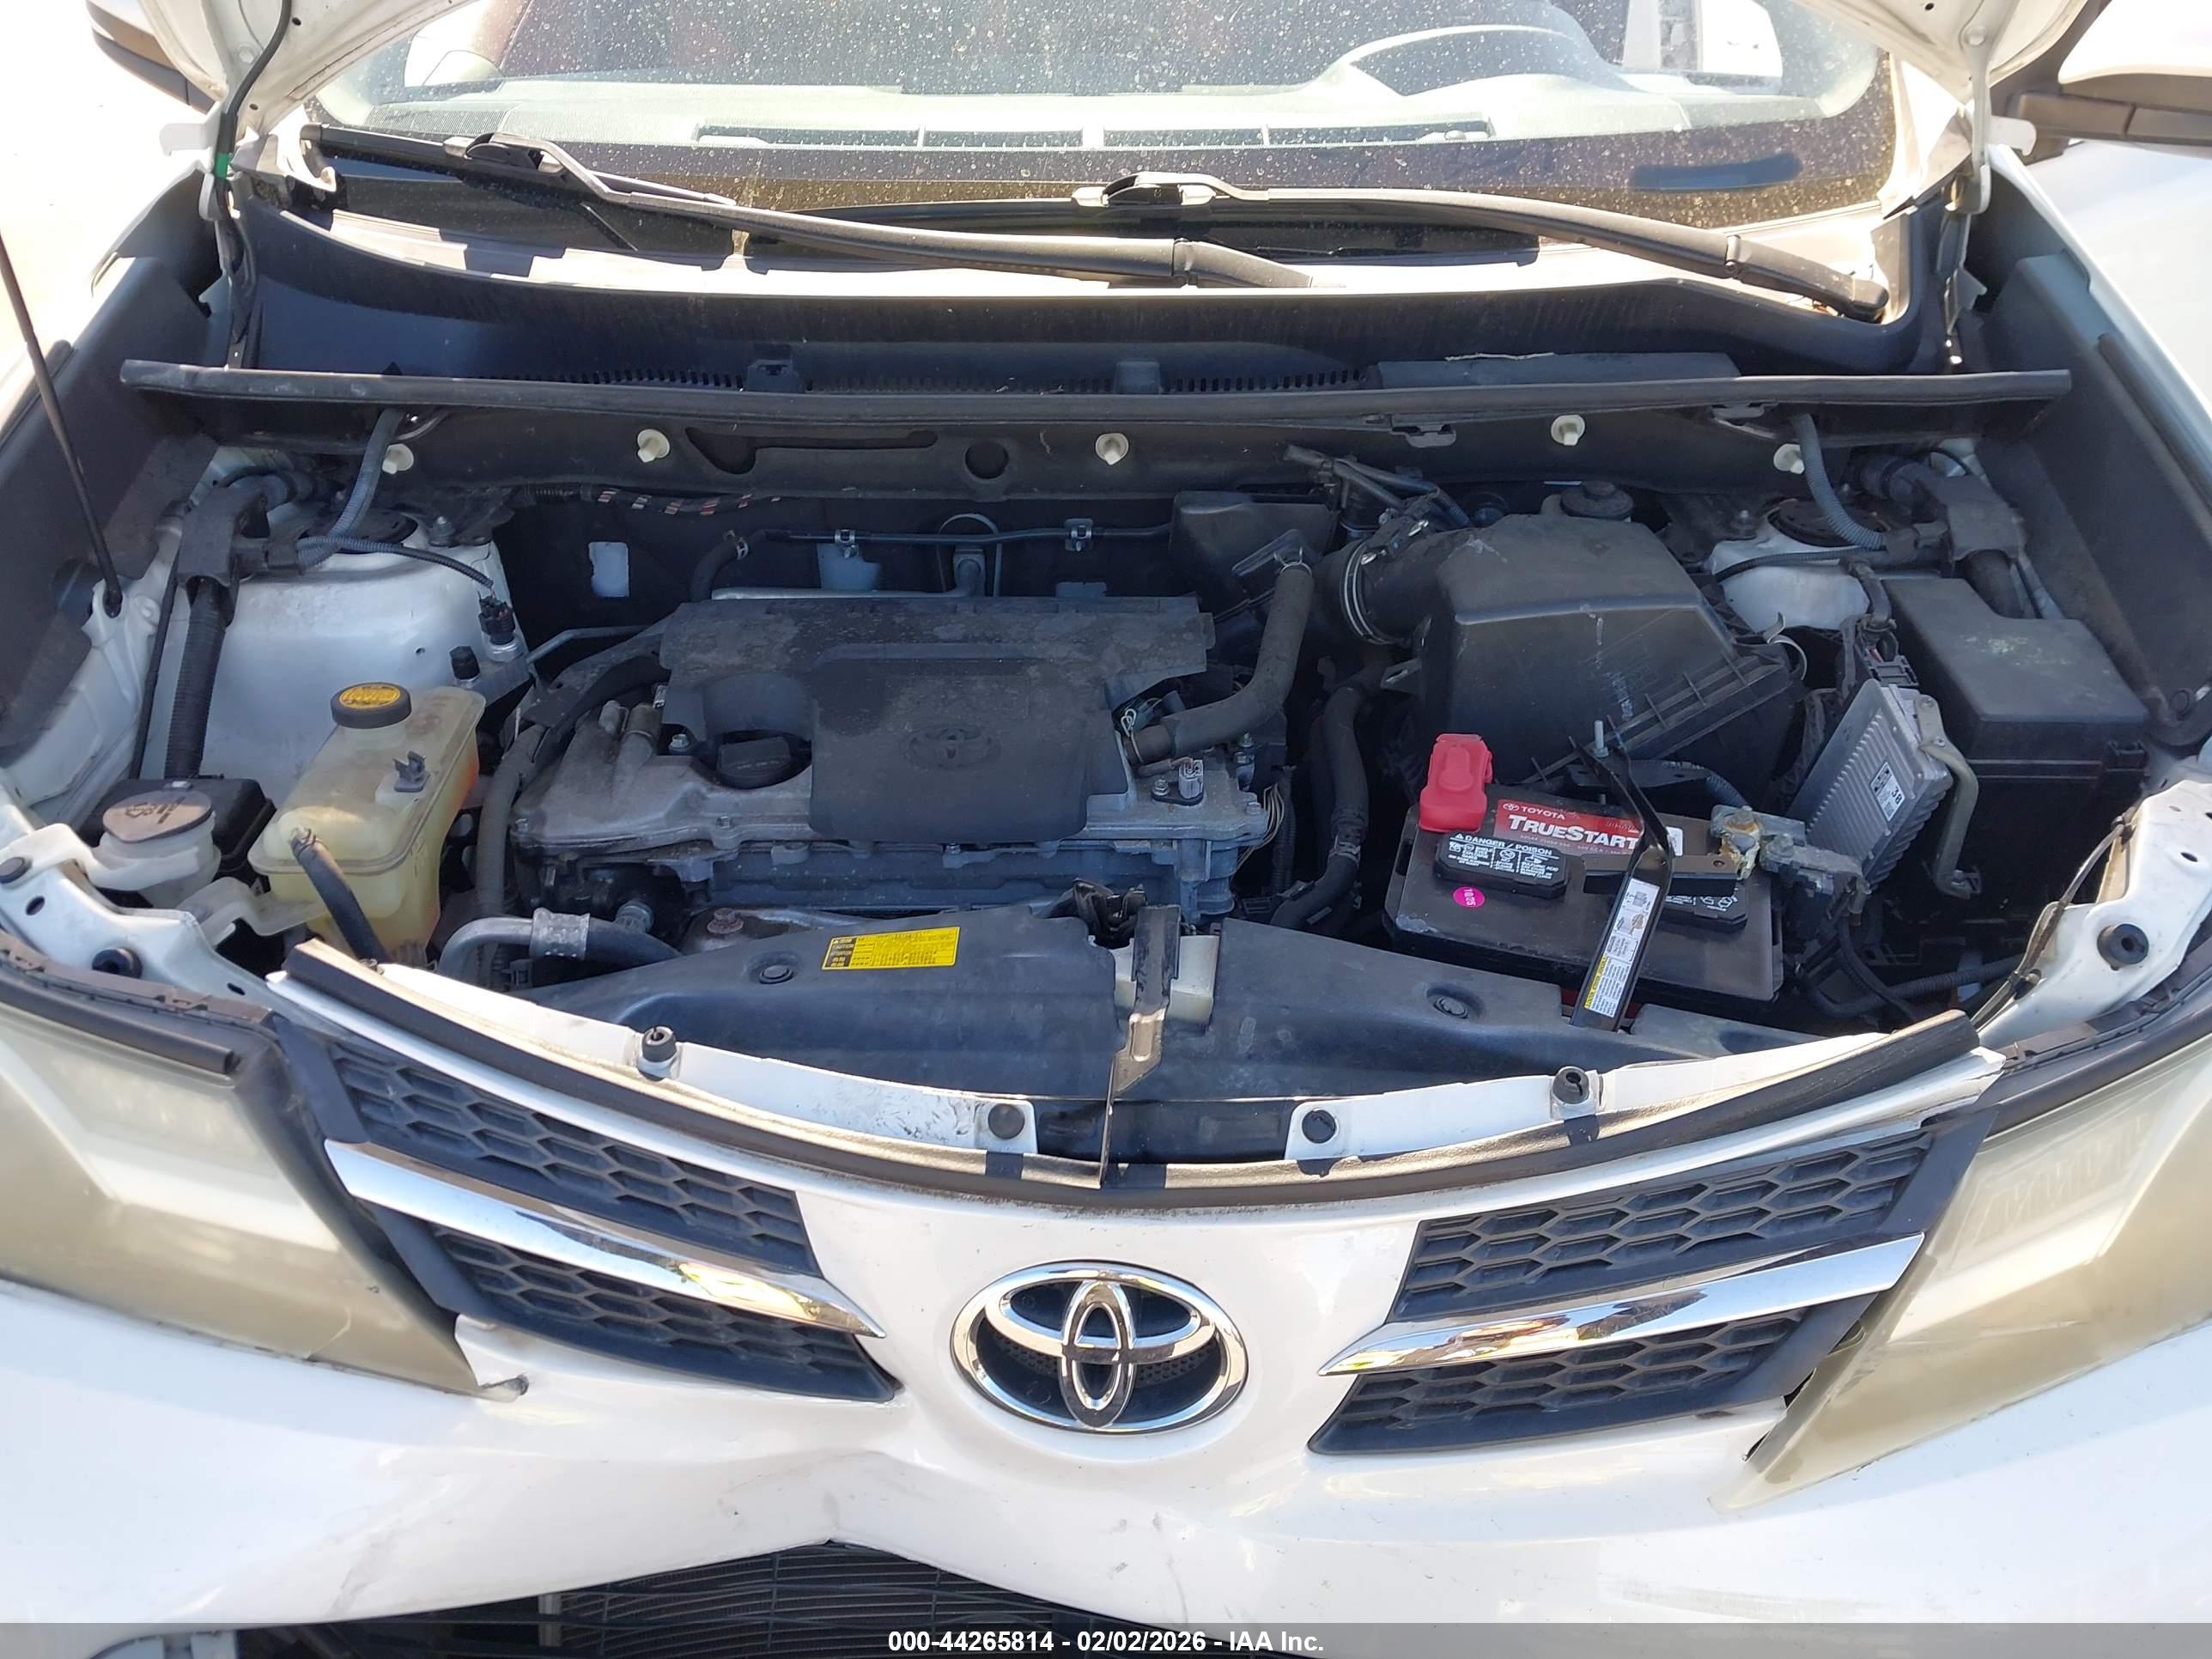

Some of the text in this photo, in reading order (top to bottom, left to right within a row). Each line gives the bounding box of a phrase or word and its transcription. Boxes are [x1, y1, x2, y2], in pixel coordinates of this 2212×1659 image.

[1521, 806, 1565, 820] TOYOTA
[1465, 835, 1505, 848] DANGER
[1516, 844, 1553, 856] POISON
